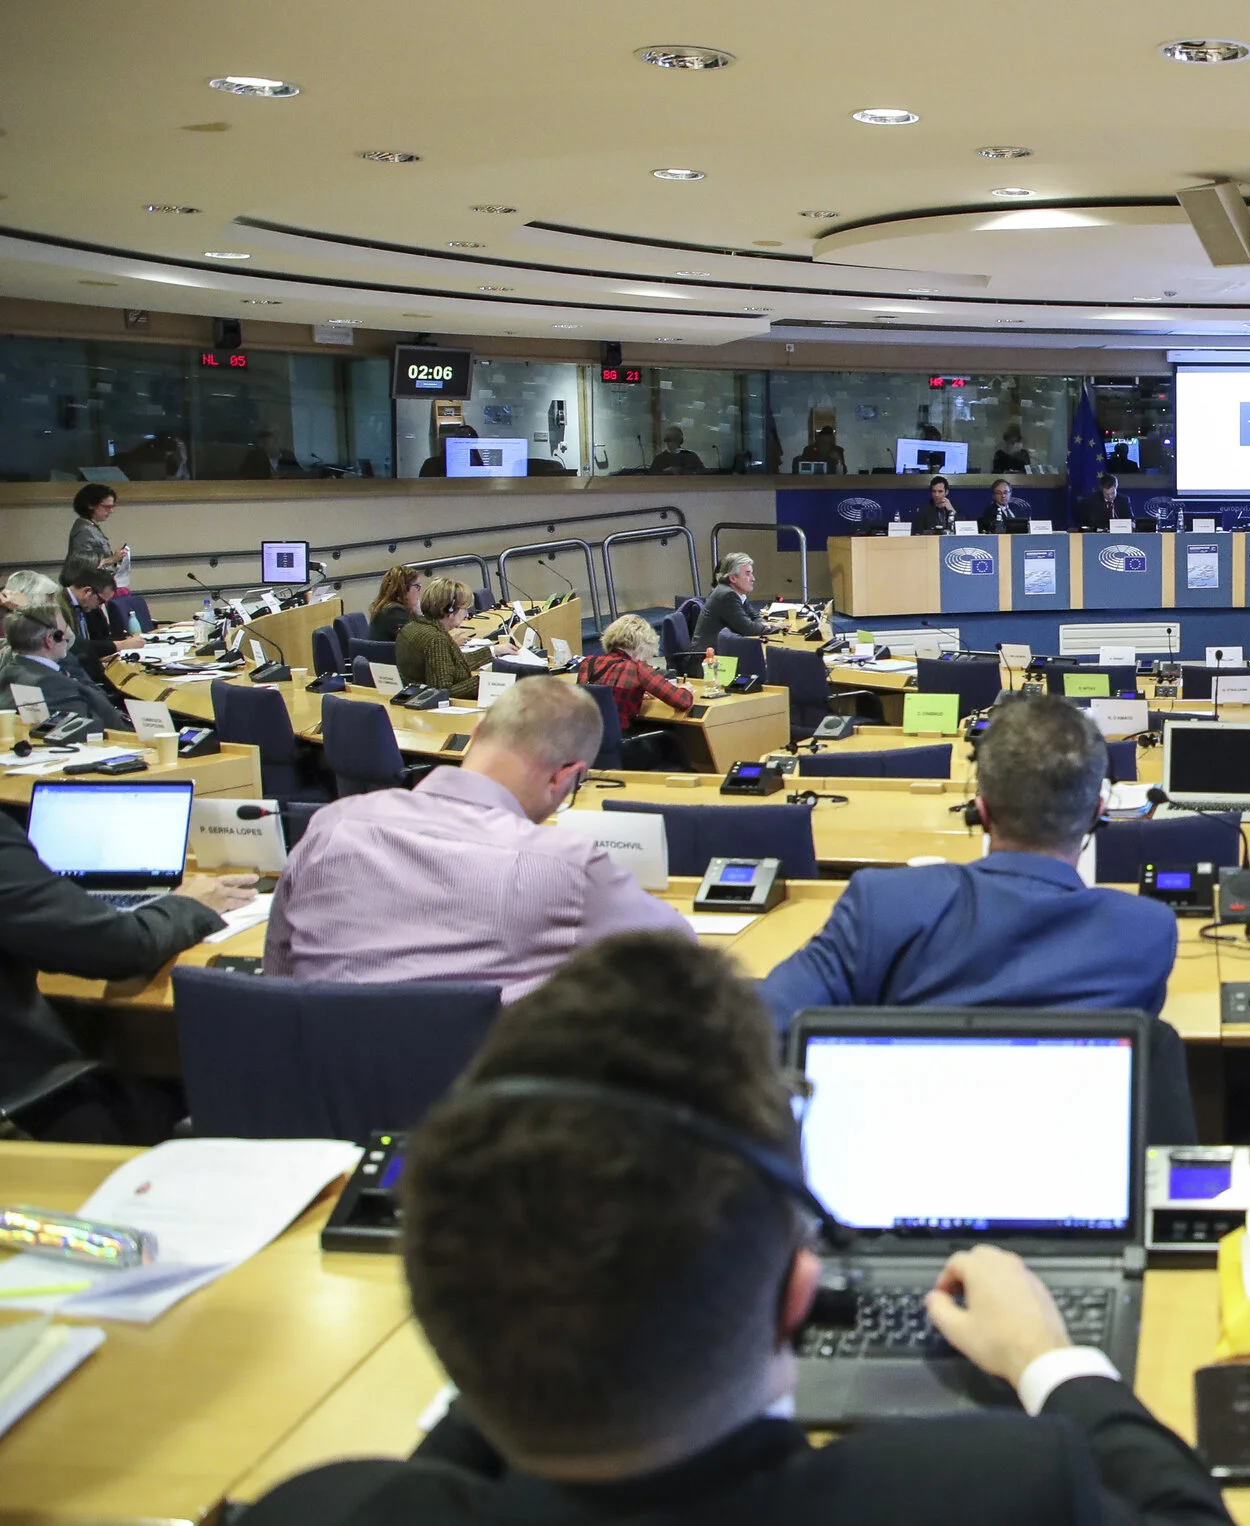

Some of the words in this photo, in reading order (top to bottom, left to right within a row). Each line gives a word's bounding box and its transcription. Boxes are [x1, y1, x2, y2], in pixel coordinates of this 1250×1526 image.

[202, 353, 219, 366] NL
[230, 355, 246, 367] 05
[408, 364, 453, 380] 02:06
[603, 370, 617, 380] BG
[626, 370, 639, 381] 21
[208, 826, 234, 834] SERRA
[236, 827, 262, 836] LOPES
